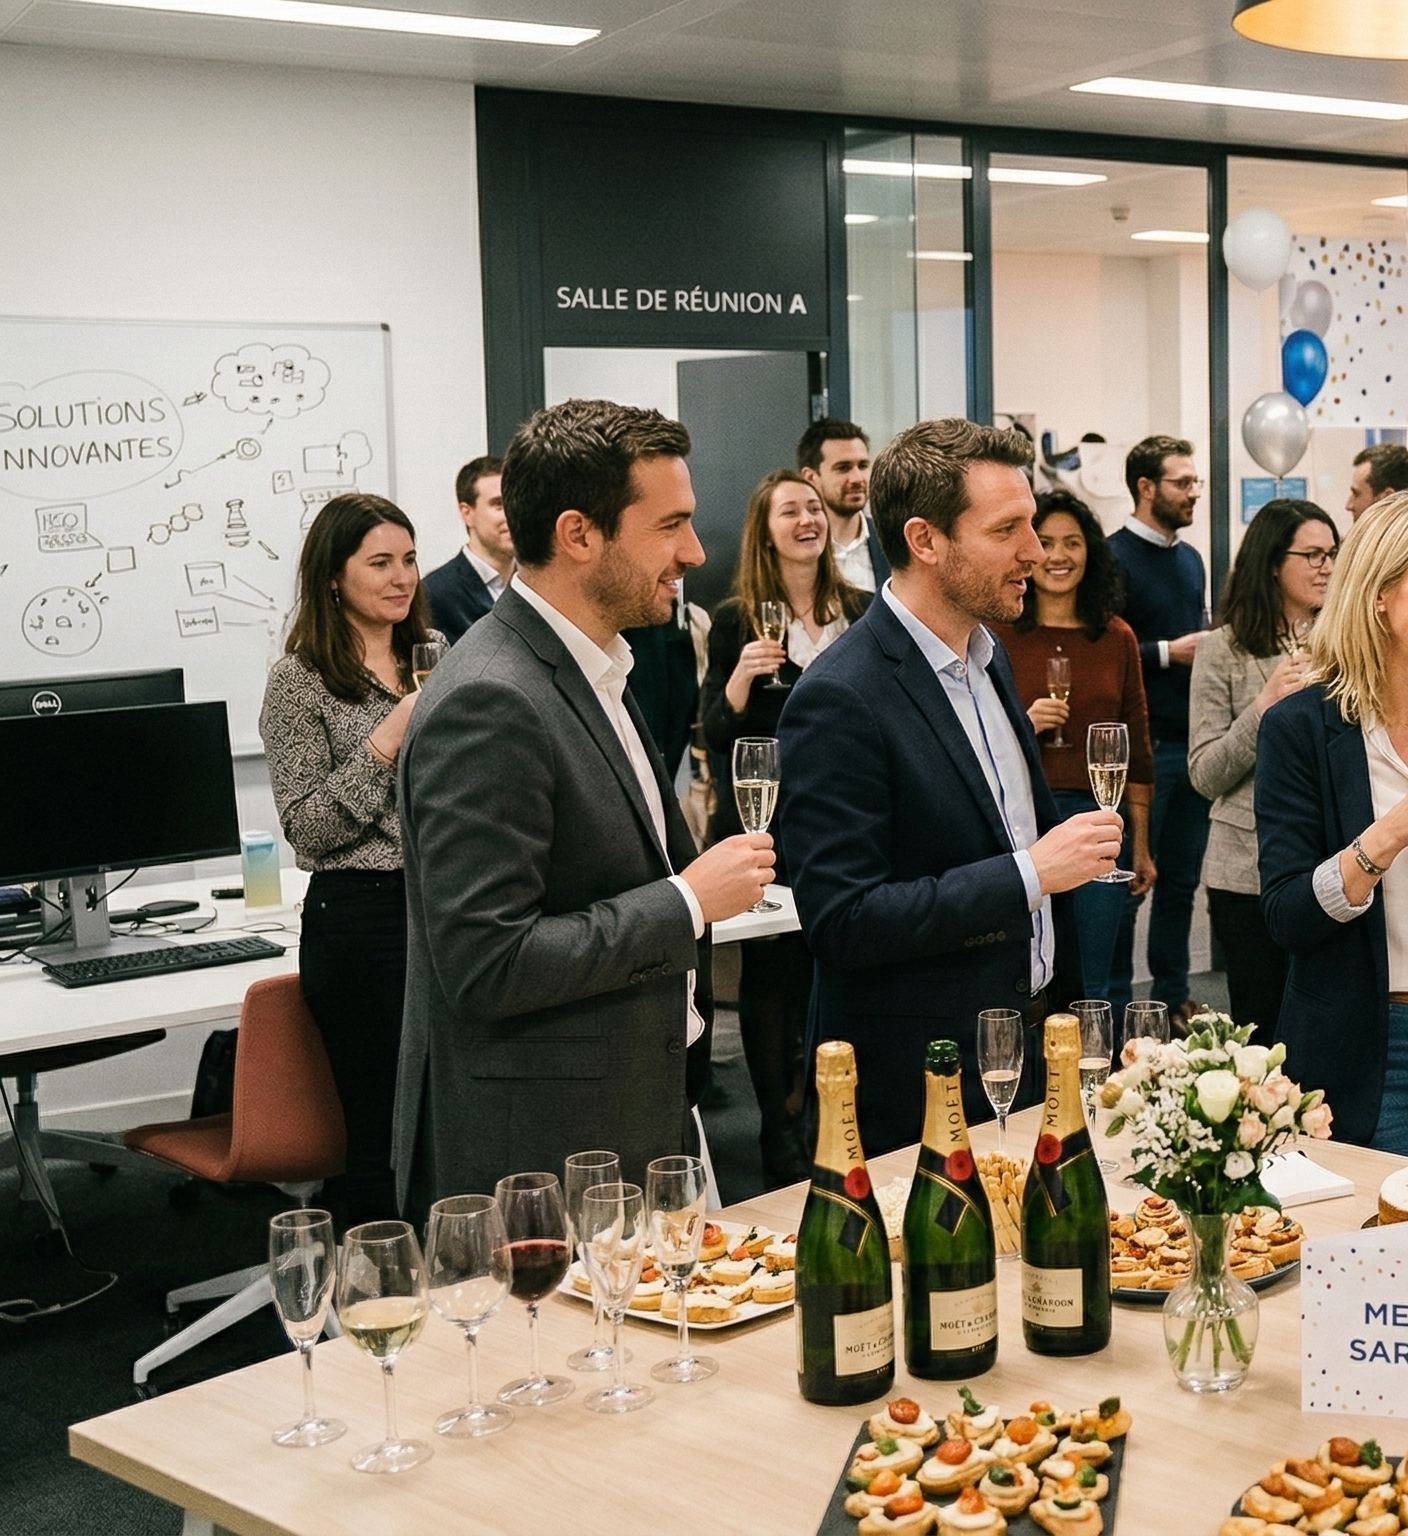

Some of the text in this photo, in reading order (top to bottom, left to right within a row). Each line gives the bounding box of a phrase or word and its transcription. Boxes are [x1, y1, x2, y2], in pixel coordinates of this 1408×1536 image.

[556, 285, 807, 315] SALLE DE RÉUNION A
[3, 436, 173, 471] NNOVANTES
